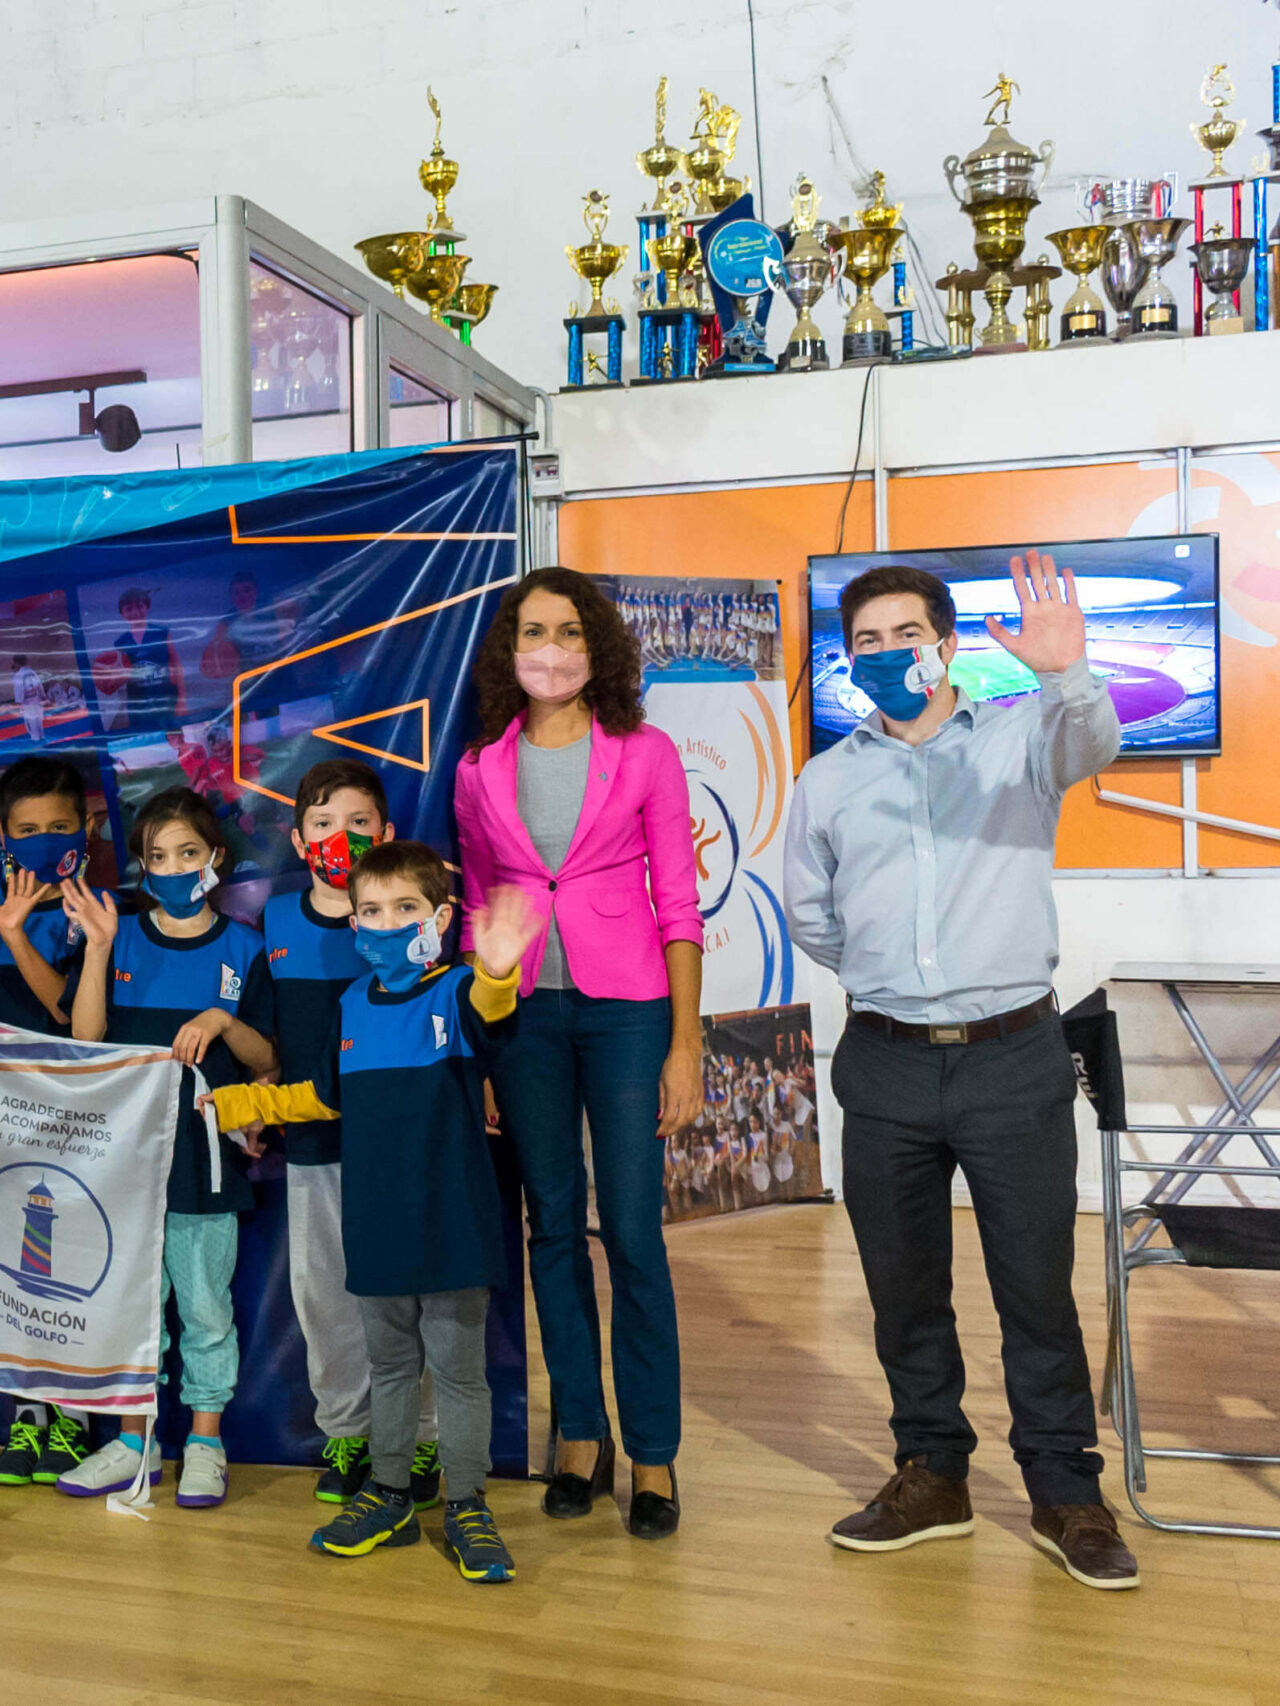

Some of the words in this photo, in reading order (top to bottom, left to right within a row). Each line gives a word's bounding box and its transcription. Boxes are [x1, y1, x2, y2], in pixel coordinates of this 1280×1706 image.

[0, 1096, 108, 1125] AGRADECEMOS
[0, 1113, 113, 1143] ACOMPAÑAMOS
[7, 1131, 43, 1147] gran
[46, 1132, 107, 1162] esfuerzo
[6, 1313, 23, 1332] DEL
[24, 1325, 68, 1345] GOLFO
